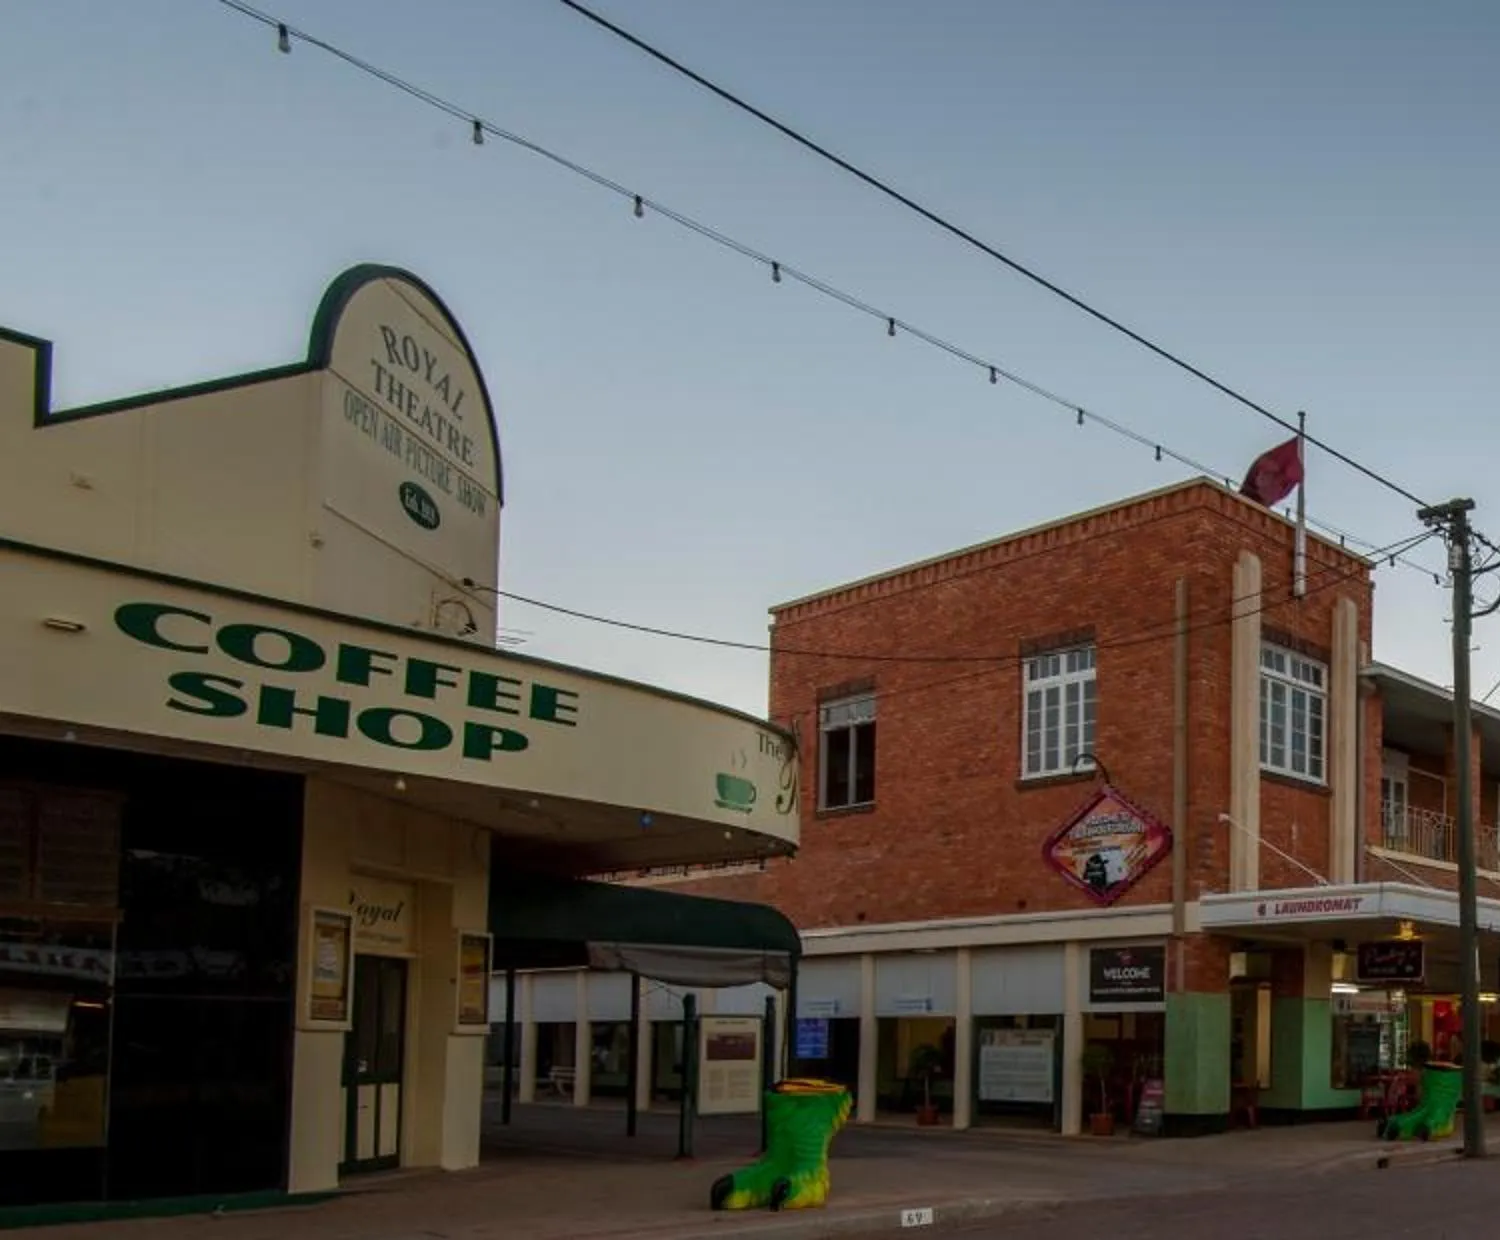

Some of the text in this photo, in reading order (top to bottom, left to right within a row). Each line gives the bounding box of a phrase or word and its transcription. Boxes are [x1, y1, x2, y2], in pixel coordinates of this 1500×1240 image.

[371, 358, 474, 466] THEATRE
[379, 325, 464, 421] ROYAL
[344, 391, 379, 441] OPEN
[381, 419, 402, 457] AIR
[405, 438, 452, 495] PICTURE
[456, 475, 486, 518] SHOW
[114, 602, 579, 727] COFFEE
[166, 671, 529, 761] SHOP
[350, 891, 408, 926] oyal
[1275, 897, 1363, 915] LAUNDROMAT
[1103, 966, 1151, 980] WELCOME
